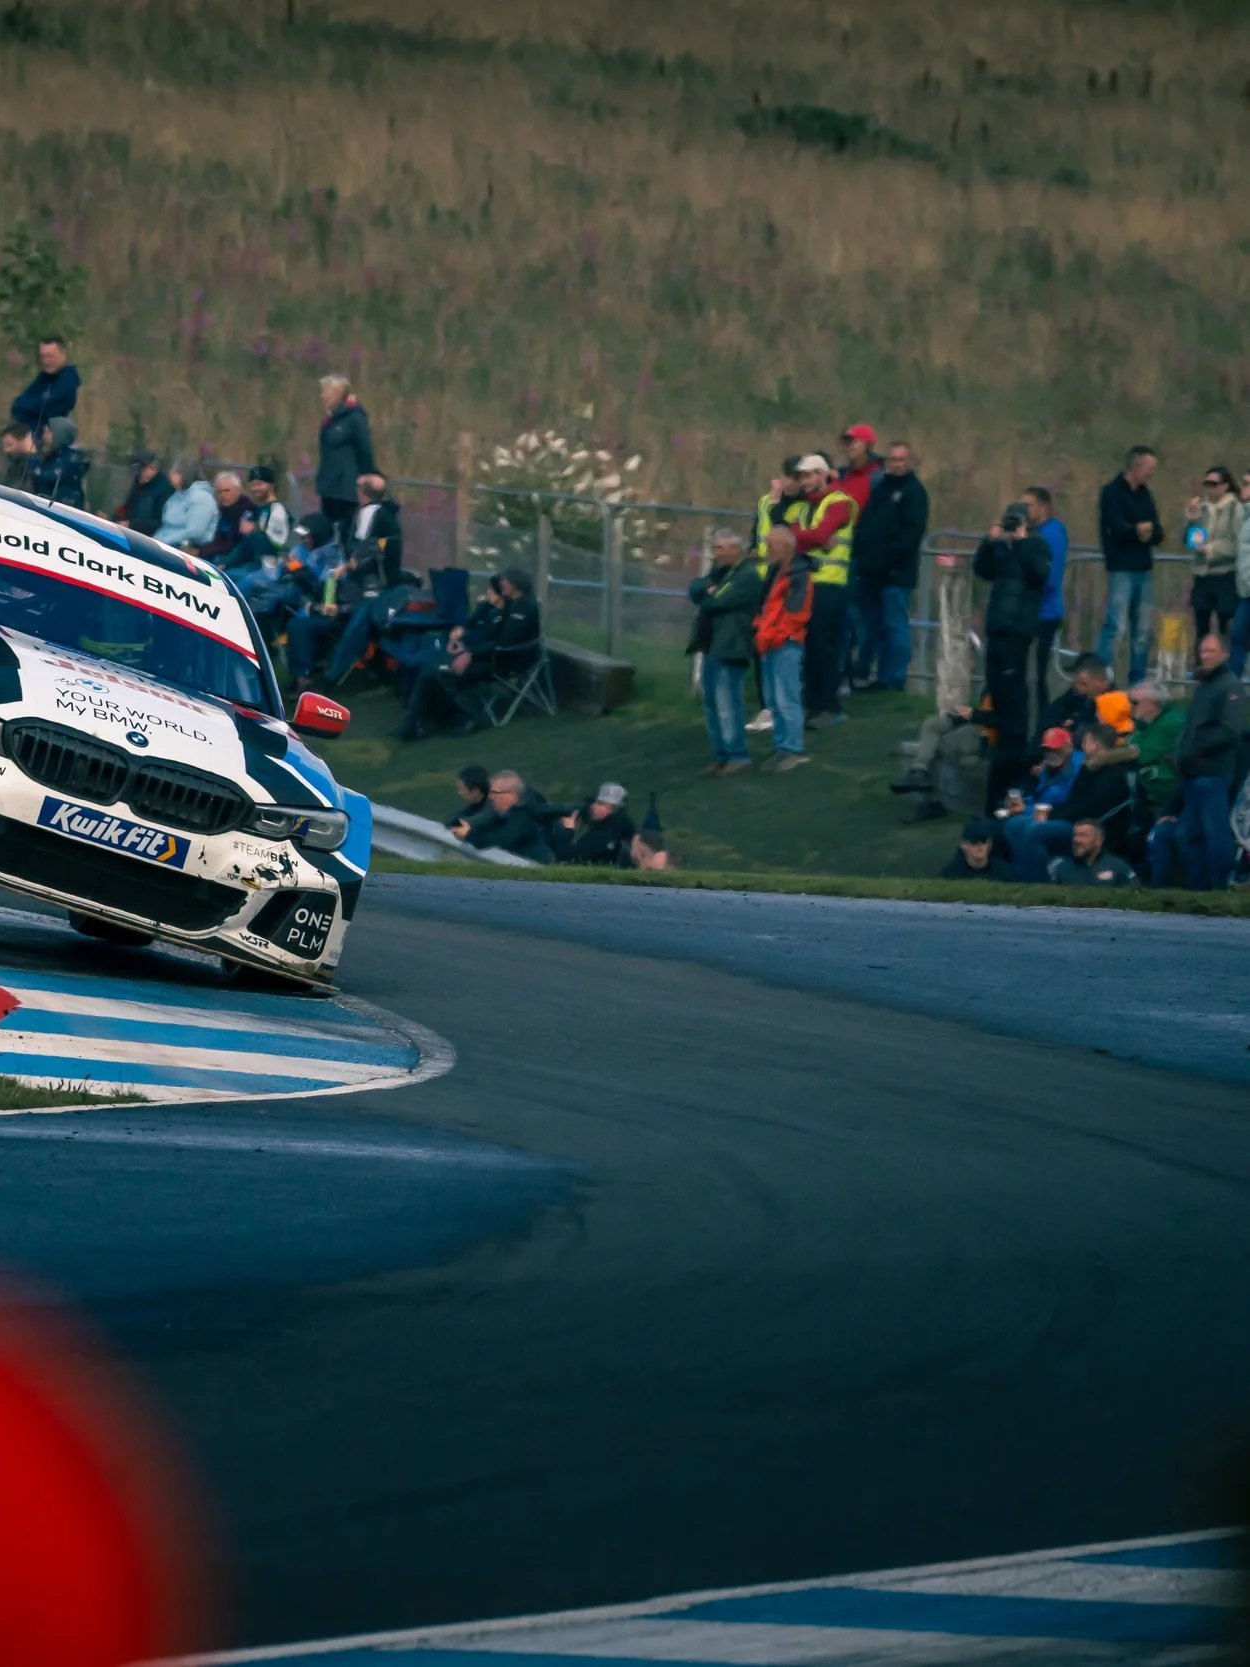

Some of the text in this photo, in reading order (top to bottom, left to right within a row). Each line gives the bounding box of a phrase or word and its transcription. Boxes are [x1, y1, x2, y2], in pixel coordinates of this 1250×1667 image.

[57, 546, 136, 586] Clark
[142, 575, 221, 620] BMW
[55, 687, 213, 746] YOUR WORLD.
[56, 698, 153, 735] My BMW.
[316, 705, 343, 720] WSR
[295, 908, 333, 932] ONE
[238, 932, 271, 949] WSR
[286, 928, 324, 953] PLM
